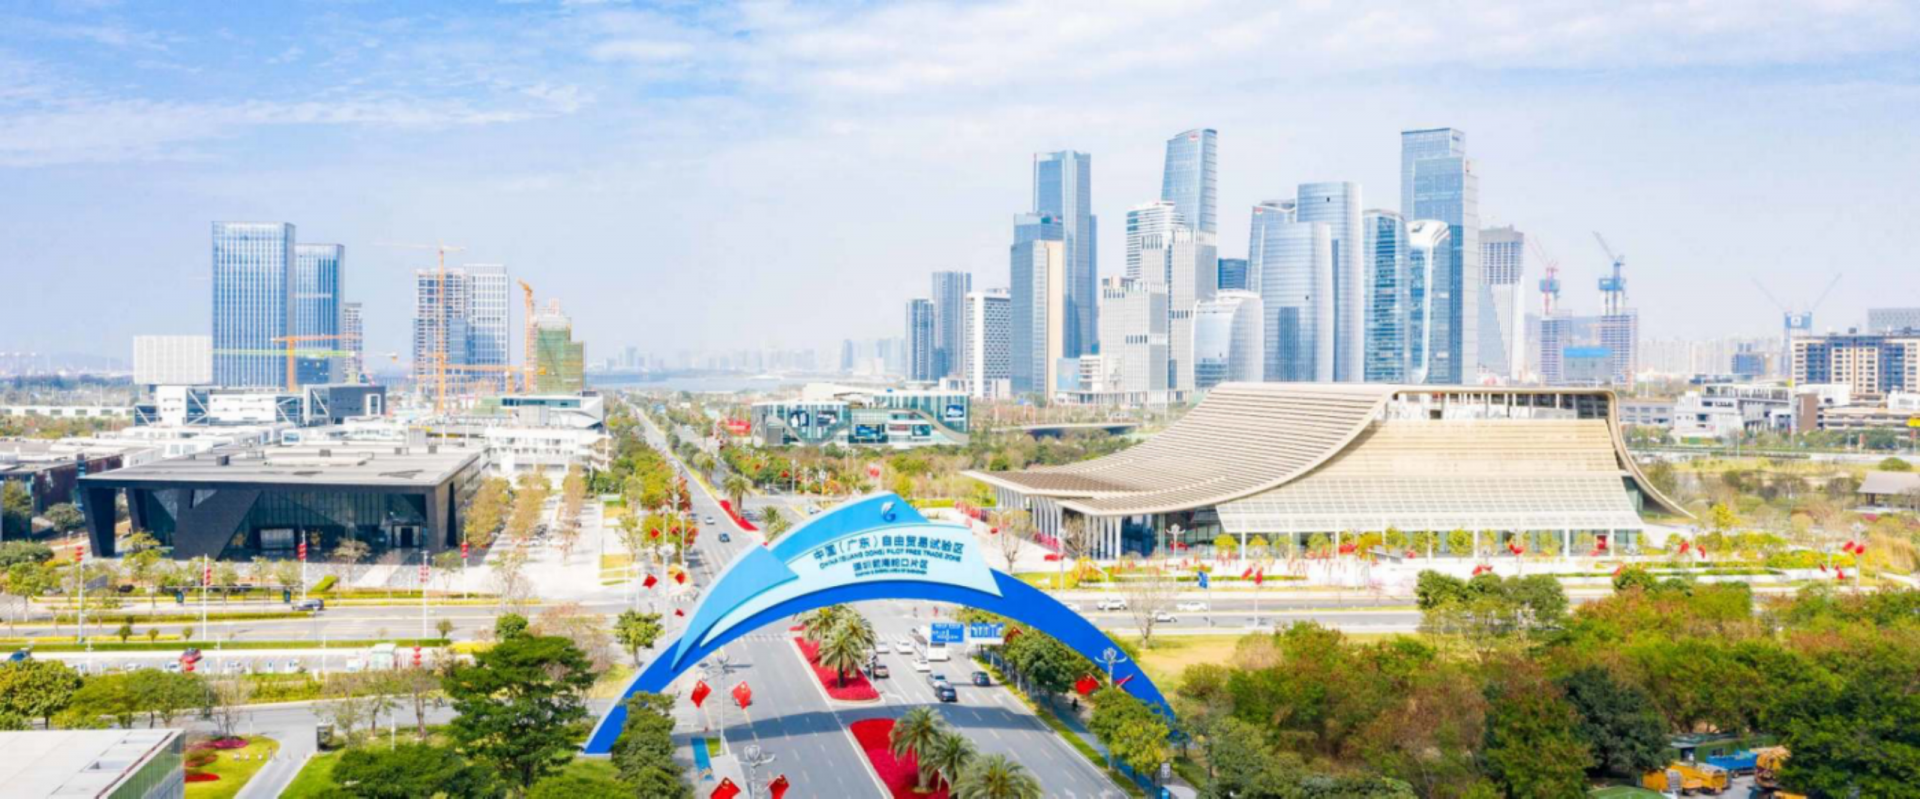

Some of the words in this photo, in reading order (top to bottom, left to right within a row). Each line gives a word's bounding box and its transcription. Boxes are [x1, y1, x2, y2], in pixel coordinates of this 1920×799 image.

[905, 548, 922, 556] FREE
[923, 550, 943, 559] TRADE
[944, 553, 961, 563] ZONE
